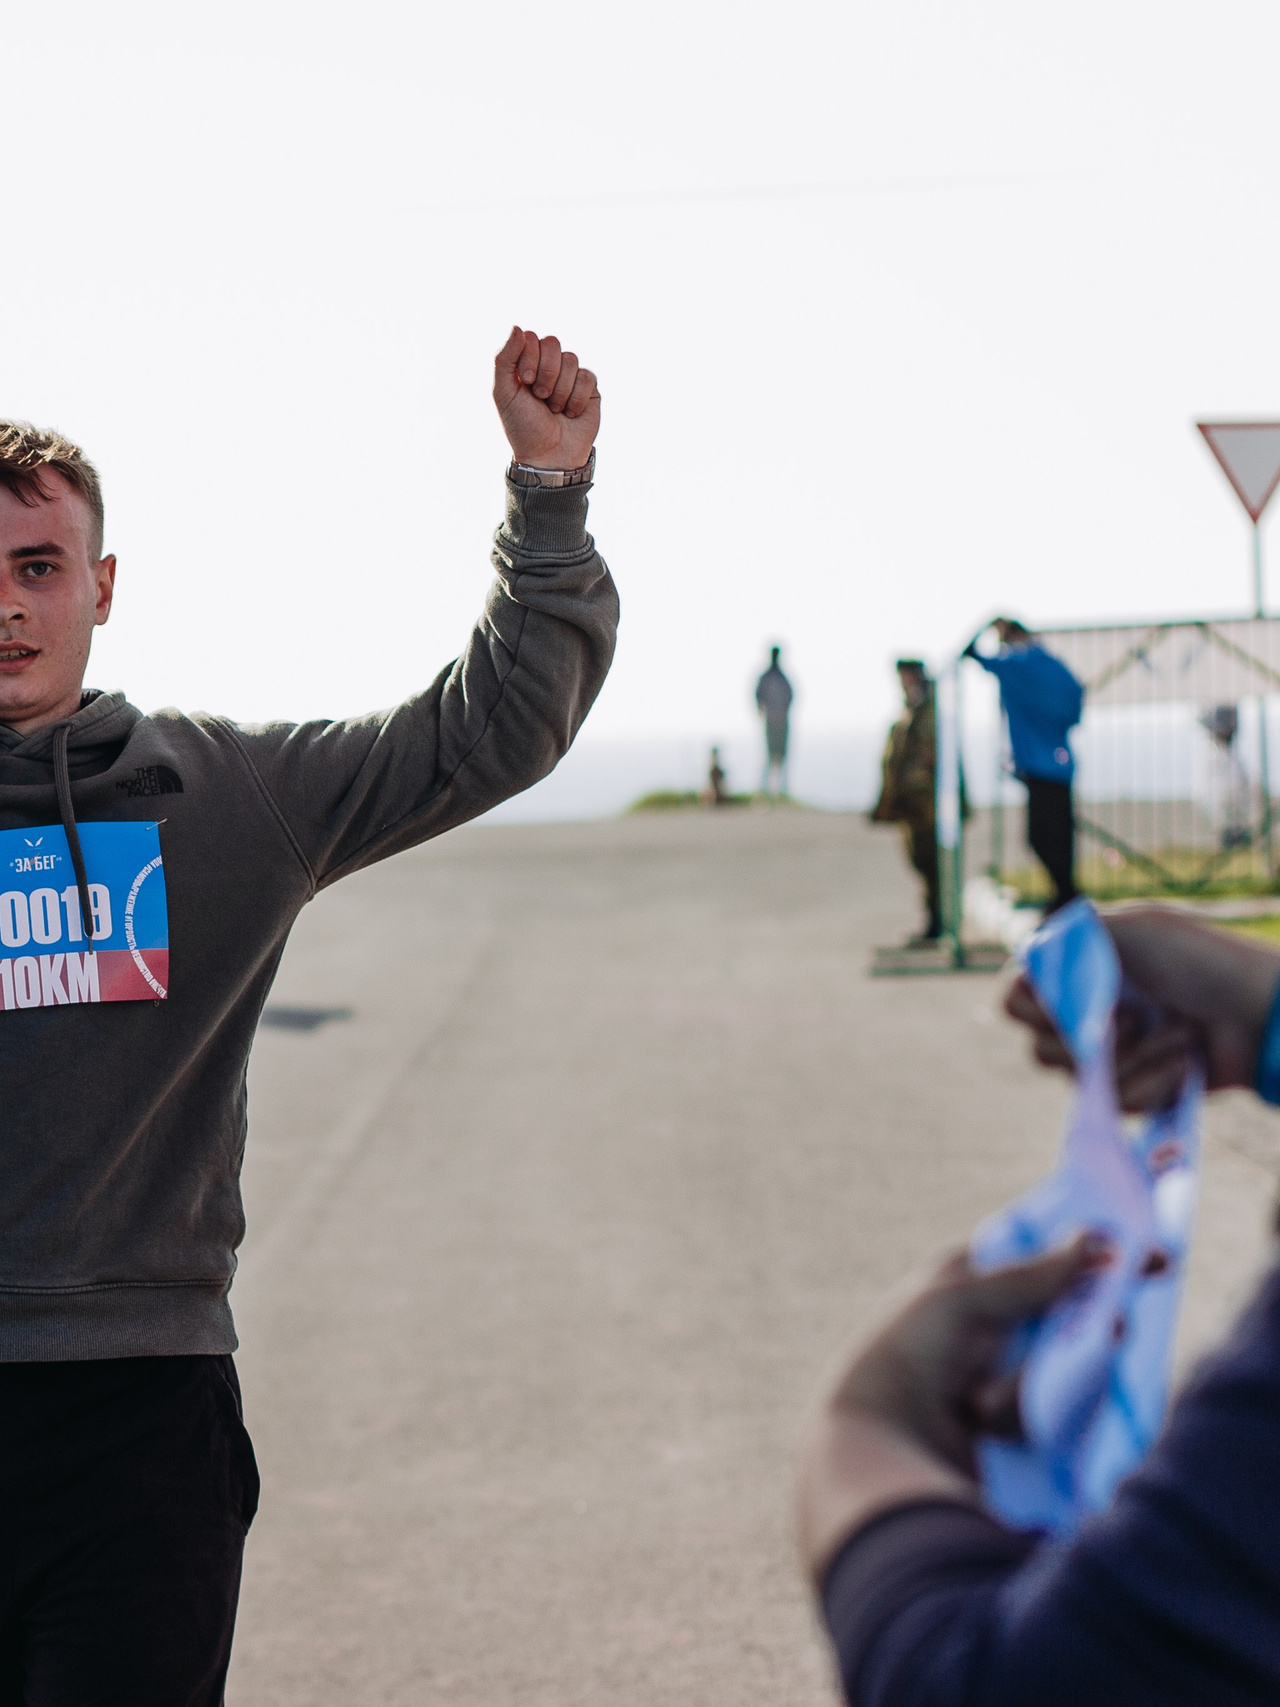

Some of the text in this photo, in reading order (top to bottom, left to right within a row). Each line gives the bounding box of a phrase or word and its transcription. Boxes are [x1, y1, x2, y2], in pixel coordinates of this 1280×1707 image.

[134, 766, 156, 776] THE
[115, 776, 158, 790] NORTH
[127, 786, 160, 797] FACE
